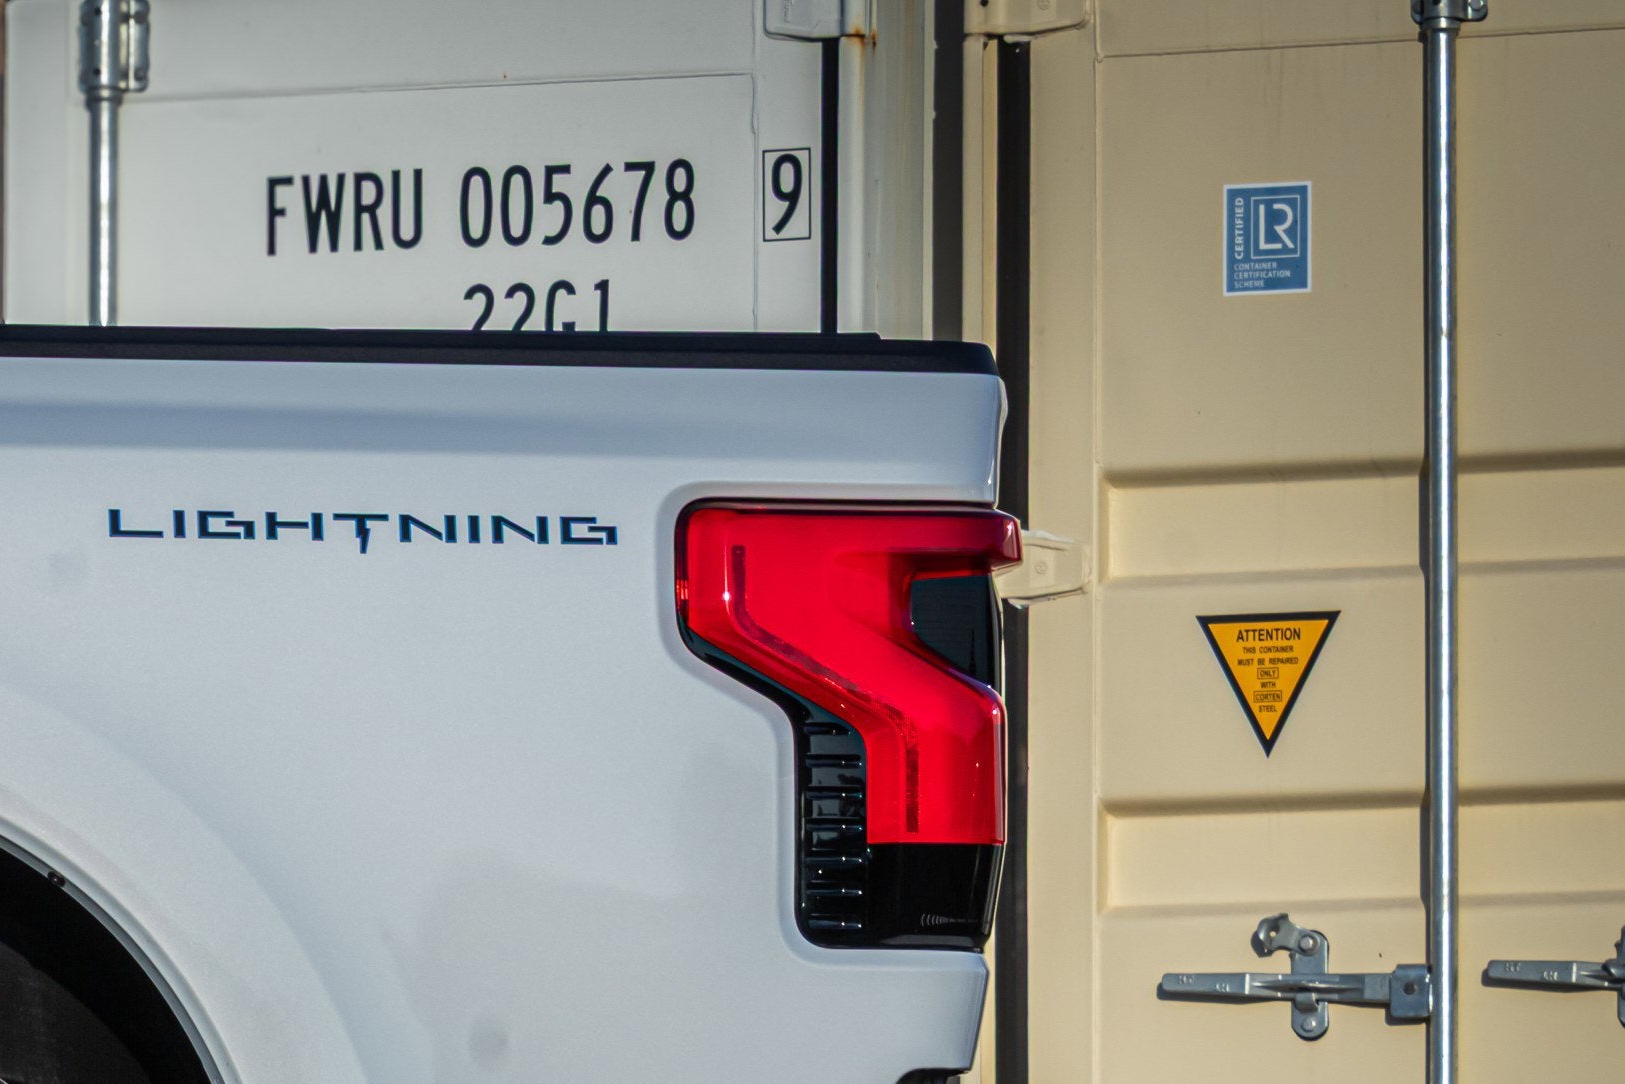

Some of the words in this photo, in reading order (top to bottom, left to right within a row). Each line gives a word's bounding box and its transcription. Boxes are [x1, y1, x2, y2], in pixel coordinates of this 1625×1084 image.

[265, 168, 424, 257] FWRU
[459, 157, 697, 248] 005678
[771, 152, 805, 237] 9
[1234, 197, 1244, 260] CERTIFIED
[1258, 203, 1295, 250] LR
[1233, 261, 1278, 270] CONTAINER
[1233, 269, 1290, 280] CERTIFICATION
[1233, 279, 1264, 288] SCHEME
[462, 278, 611, 332] 22G1
[107, 508, 620, 555] LIGHTNING
[1236, 627, 1300, 642] ATTENTION
[1258, 645, 1294, 654] CONTAINER
[1268, 656, 1298, 664] REPAIRED
